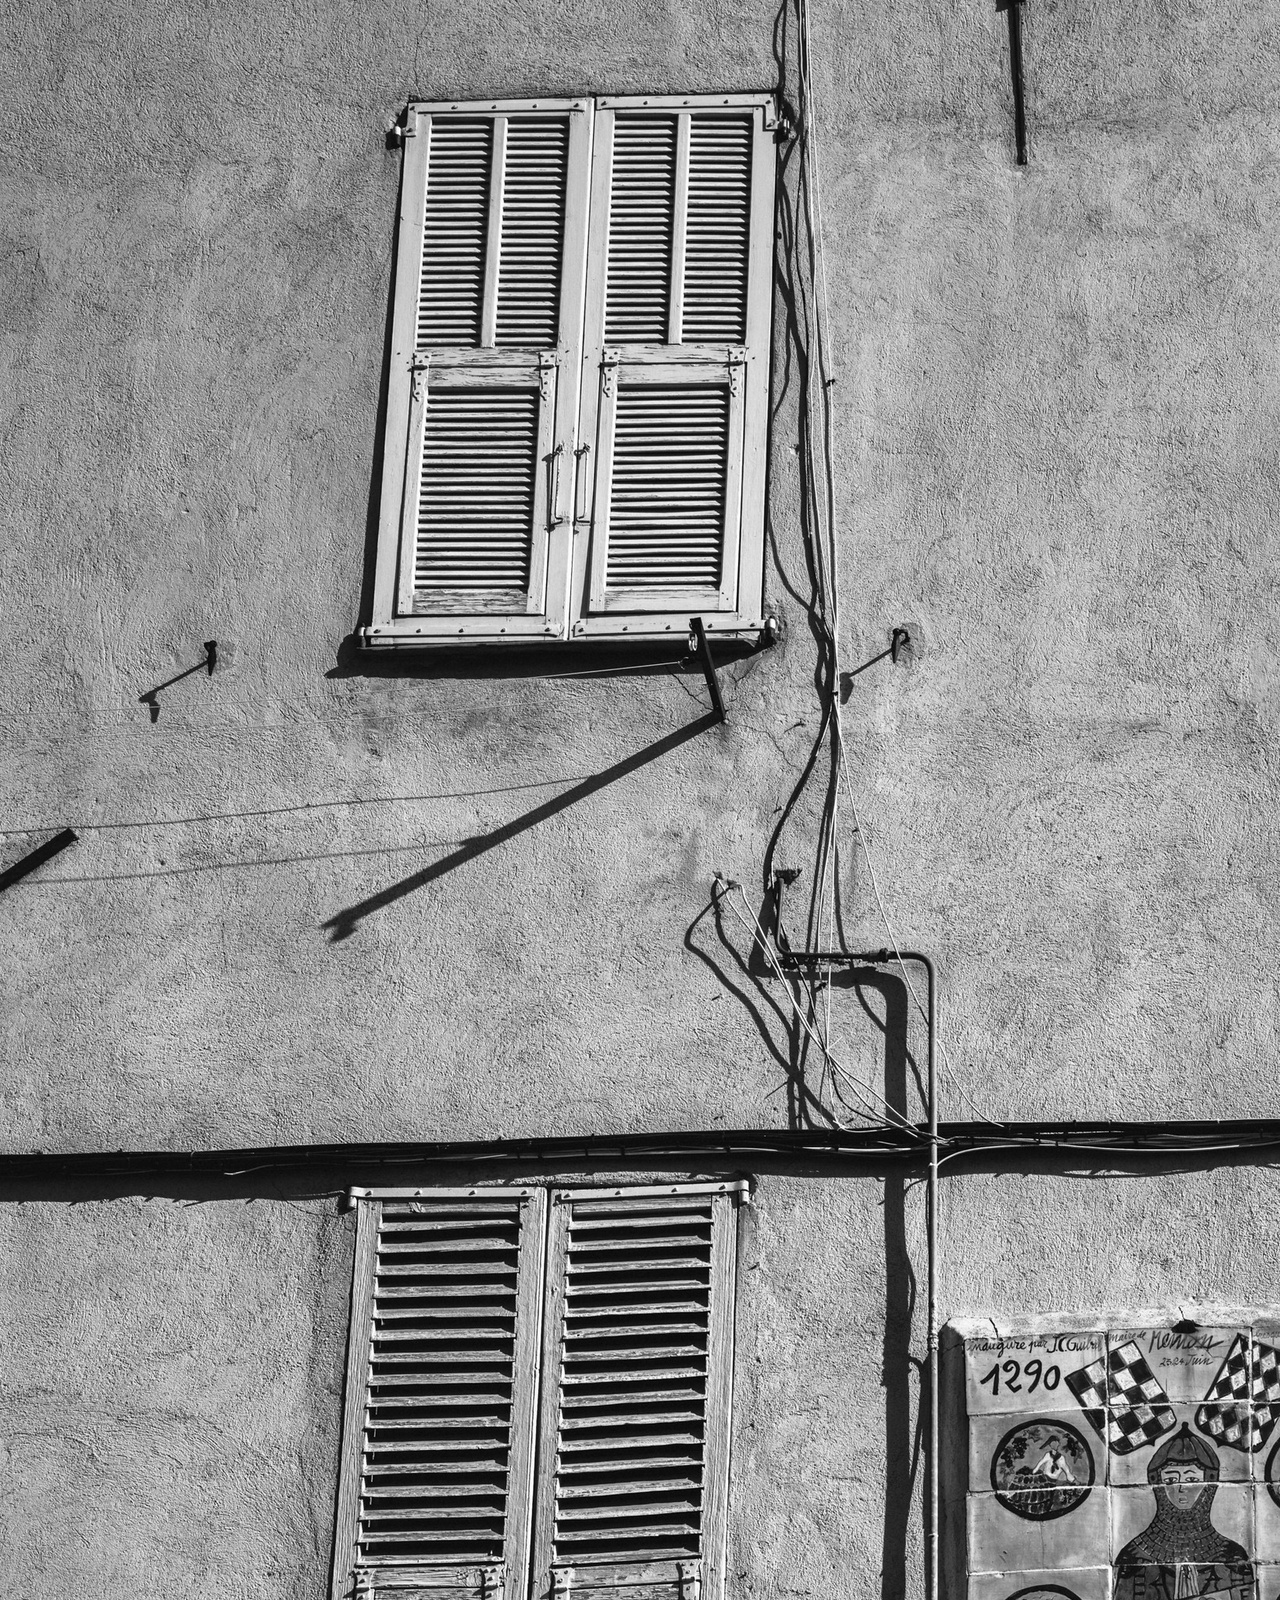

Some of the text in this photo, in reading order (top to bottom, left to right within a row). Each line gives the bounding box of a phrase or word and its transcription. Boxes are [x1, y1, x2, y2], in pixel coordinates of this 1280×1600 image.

[1028, 1340, 1048, 1353] par
[1184, 1354, 1213, 1366] Juin
[980, 1359, 1061, 1395] 1290
